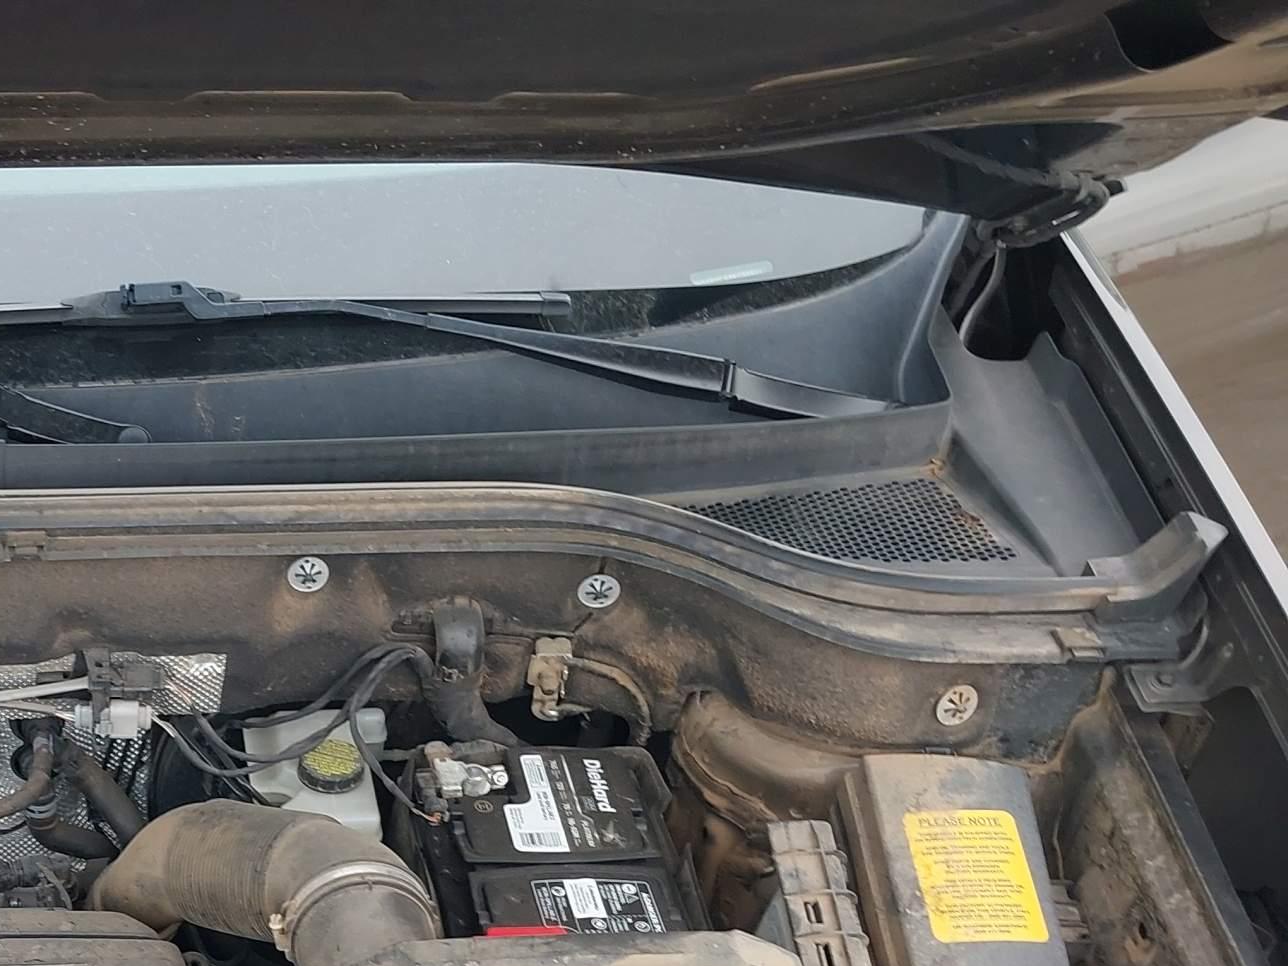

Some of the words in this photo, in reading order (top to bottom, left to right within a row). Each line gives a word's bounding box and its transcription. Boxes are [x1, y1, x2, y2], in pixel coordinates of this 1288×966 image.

[582, 758, 616, 813] DieHard
[919, 817, 966, 827] PLEASE
[968, 816, 1001, 827] NOTE
